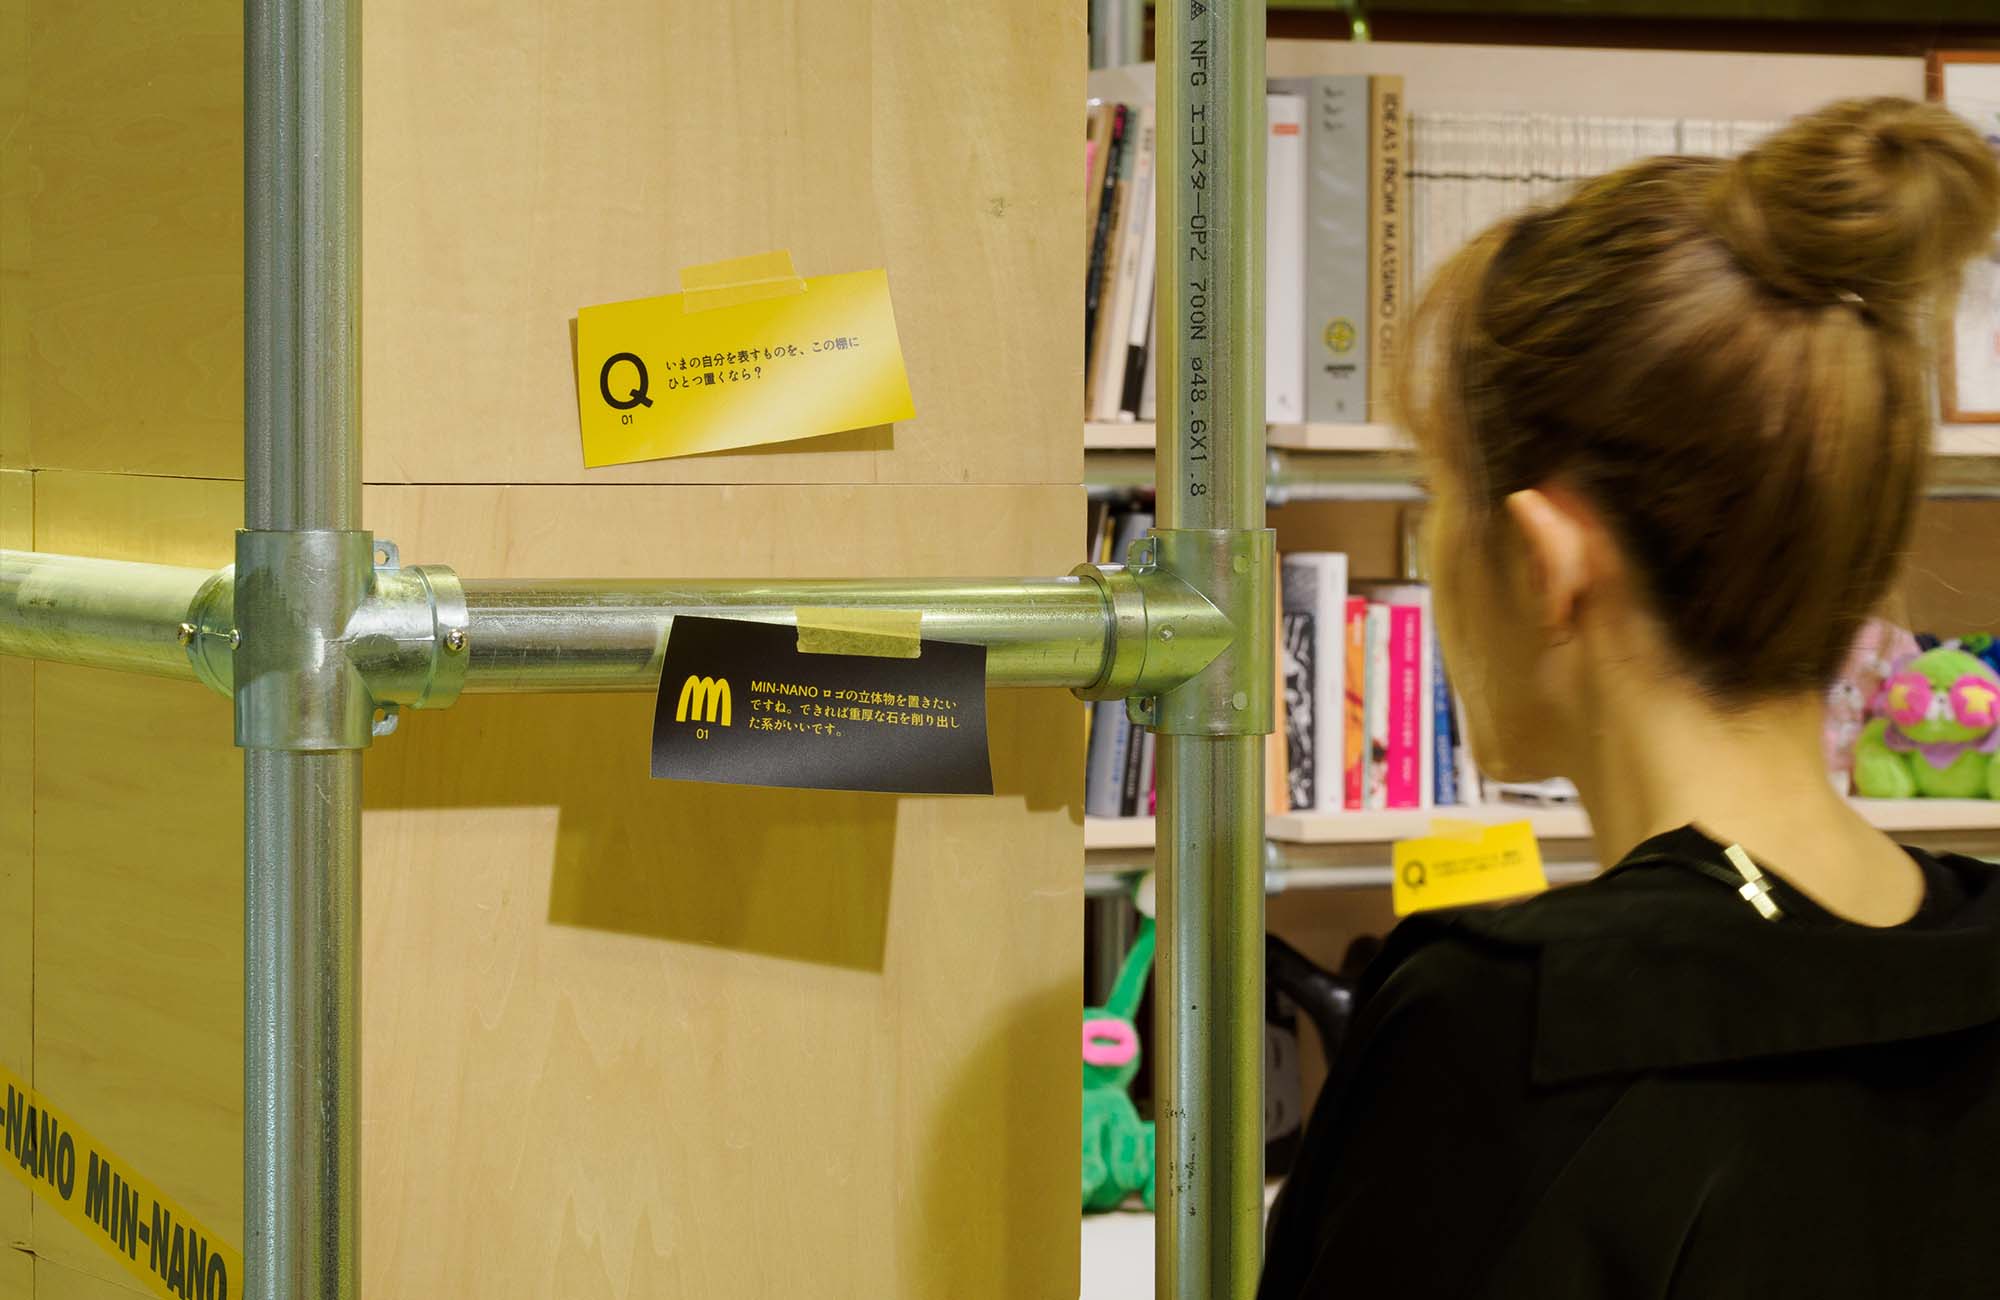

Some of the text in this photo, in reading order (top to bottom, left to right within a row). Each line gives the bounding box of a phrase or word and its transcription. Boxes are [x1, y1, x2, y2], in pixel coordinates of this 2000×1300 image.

[1190, 40, 1207, 87] NFG
[1382, 92, 1398, 152] IDEAS
[1382, 157, 1398, 216] FROM
[1380, 220, 1398, 319] MASSIMO
[1190, 278, 1207, 341] 700N
[666, 337, 860, 371] いまの自分を表すものを、この棚に
[600, 352, 654, 410] Q
[621, 414, 634, 425] 01
[750, 698, 961, 729] ですね。できれば重厚な石を削り出し
[751, 680, 958, 710] MIN-NANO ロゴの立体物を置きたい
[696, 728, 709, 740] 01
[749, 716, 842, 737] た系がいいです。
[1402, 860, 1427, 889] Q
[84, 1149, 228, 1300] MIN-NANO
